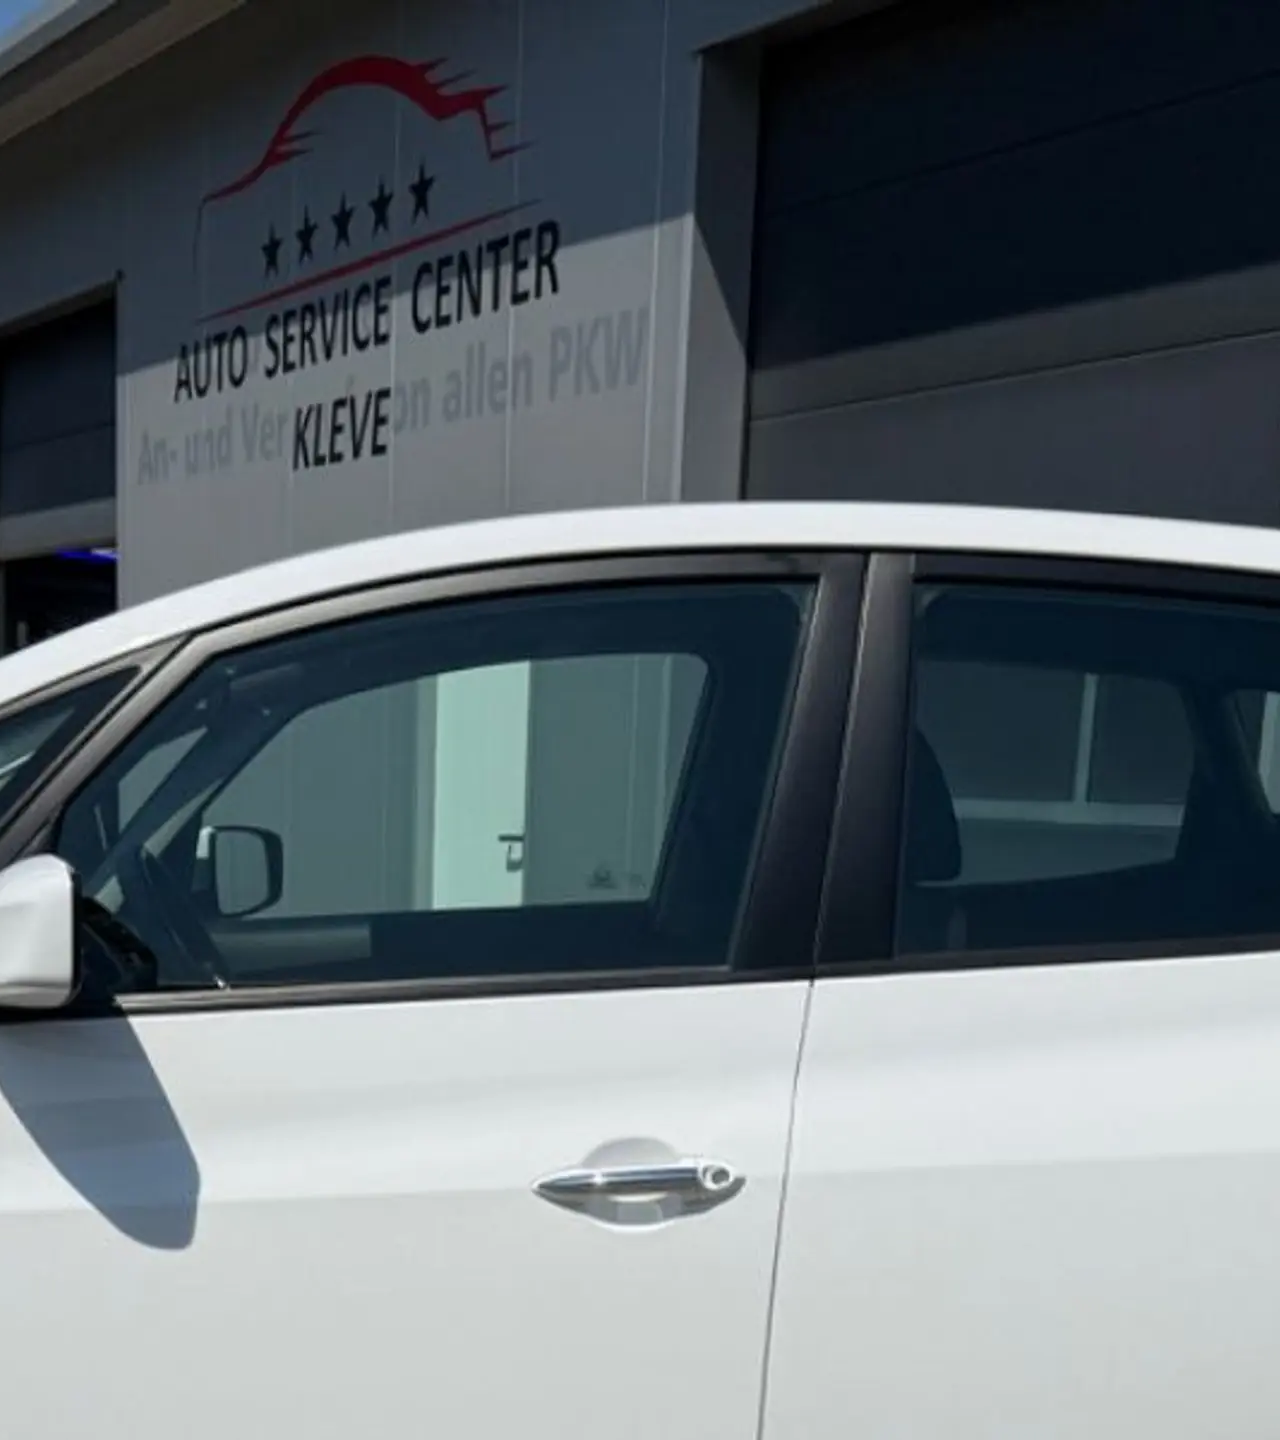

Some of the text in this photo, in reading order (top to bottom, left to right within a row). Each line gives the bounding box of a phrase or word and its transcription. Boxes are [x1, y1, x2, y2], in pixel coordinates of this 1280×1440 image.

[175, 220, 560, 403] AUTO SERVICE CENTER
[184, 403, 233, 475] und
[442, 341, 534, 424] allen
[548, 309, 646, 404] PKW
[292, 388, 391, 471] KLEVE
